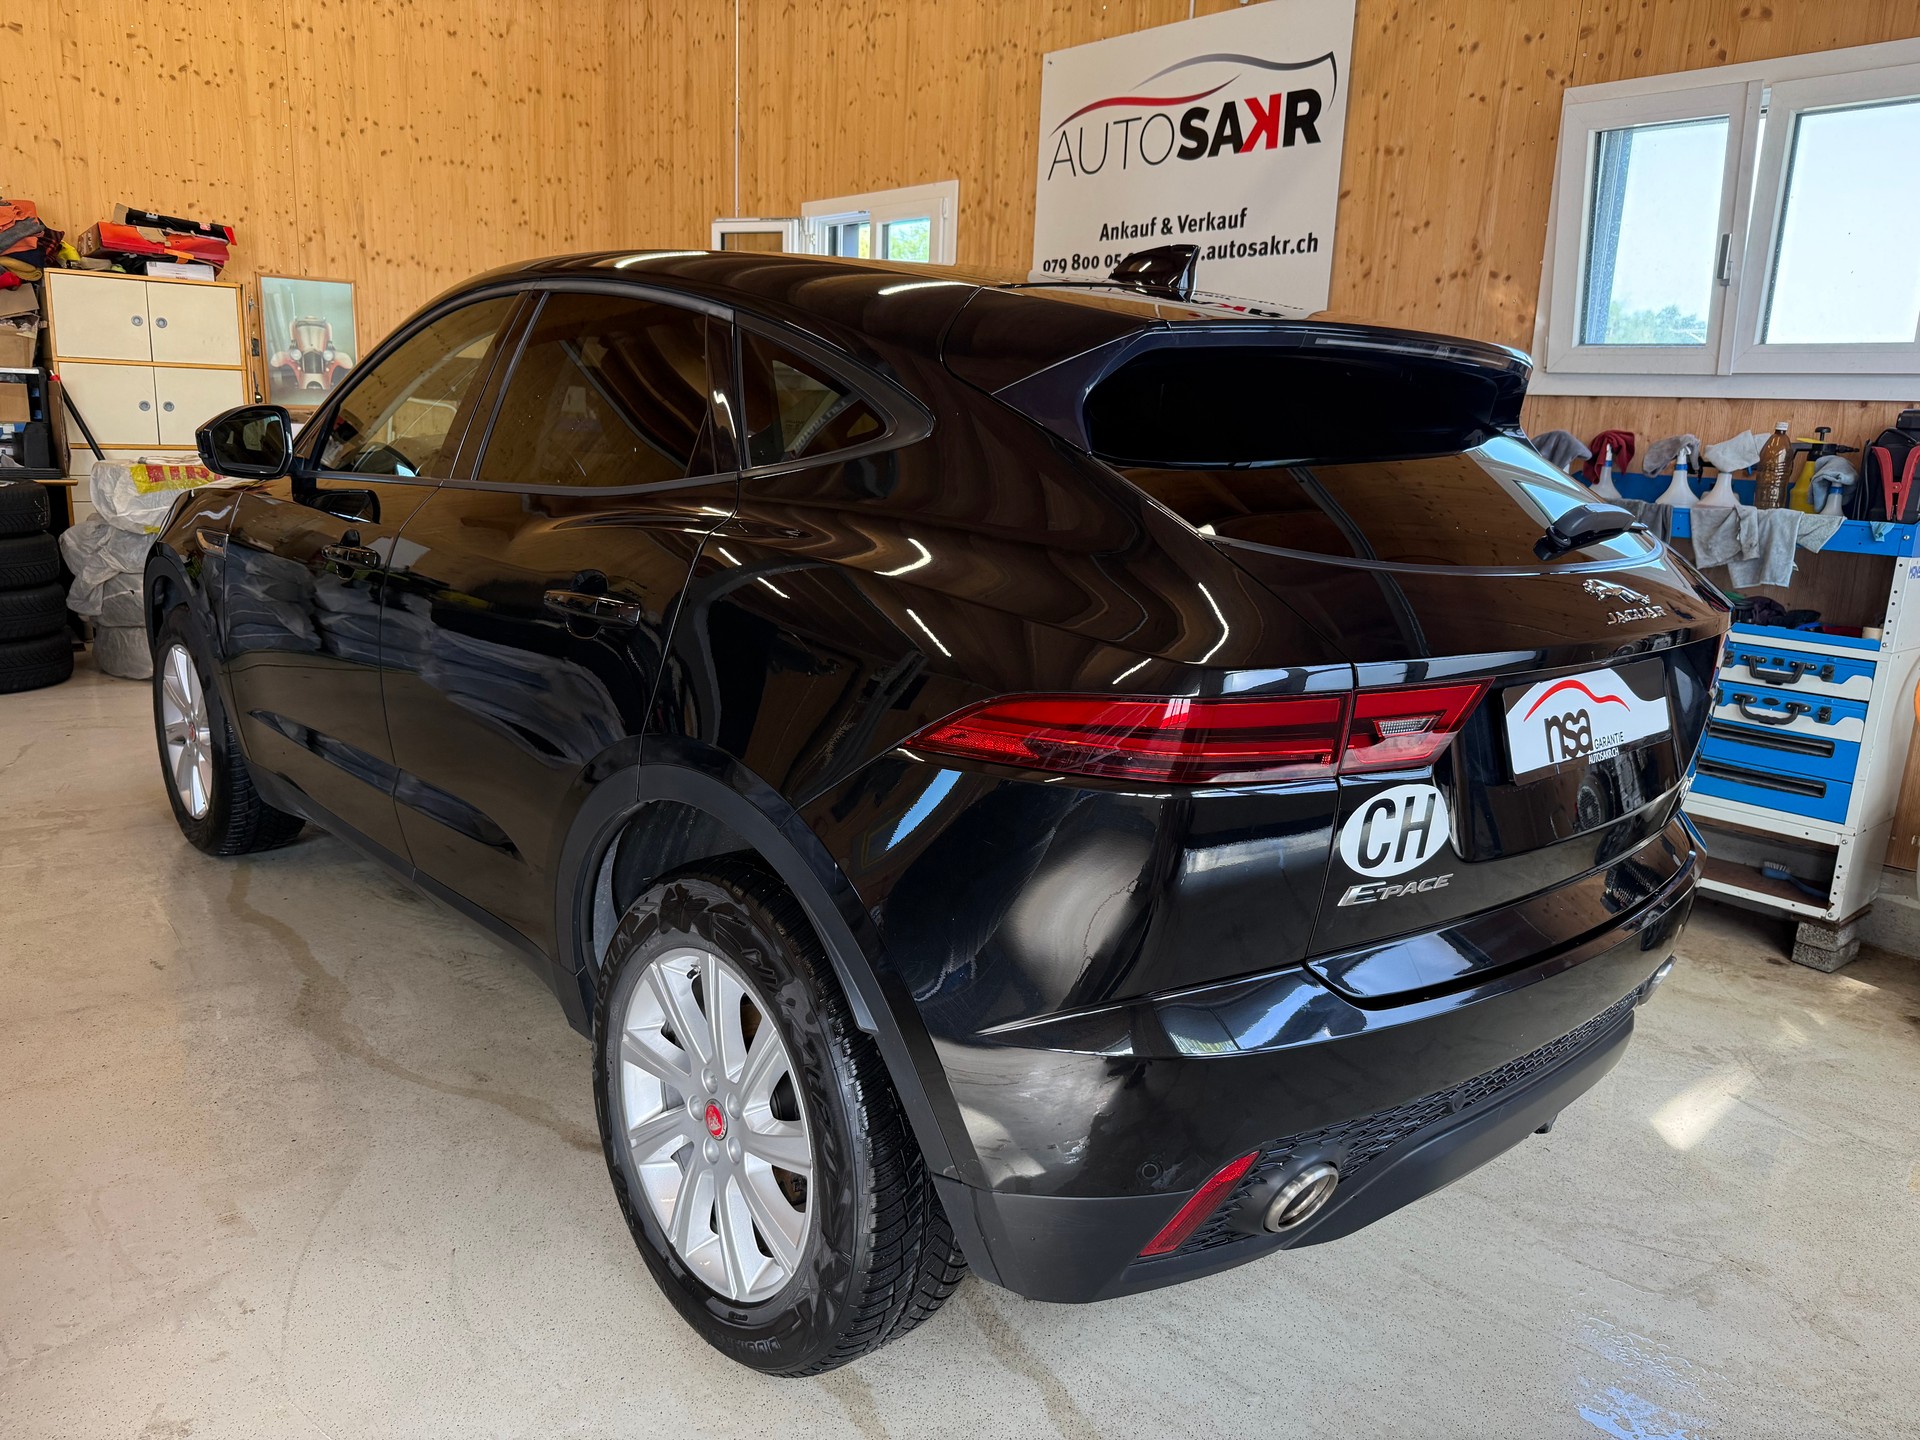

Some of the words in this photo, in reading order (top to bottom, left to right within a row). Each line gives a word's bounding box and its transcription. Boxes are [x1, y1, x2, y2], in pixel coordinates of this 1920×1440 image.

[1047, 87, 1323, 181] AUTOSAKR
[1099, 217, 1158, 242] Ankauf
[1160, 217, 1174, 235] &
[1177, 207, 1248, 235] Verkauf
[1043, 258, 1067, 273] 079
[1071, 253, 1100, 271] 800
[1199, 232, 1319, 262] .autosakr.ch
[1607, 605, 1668, 625] JAGUAR
[1543, 708, 1594, 763] nsa
[1594, 731, 1624, 749] GARANTIE
[1357, 793, 1437, 869] CH
